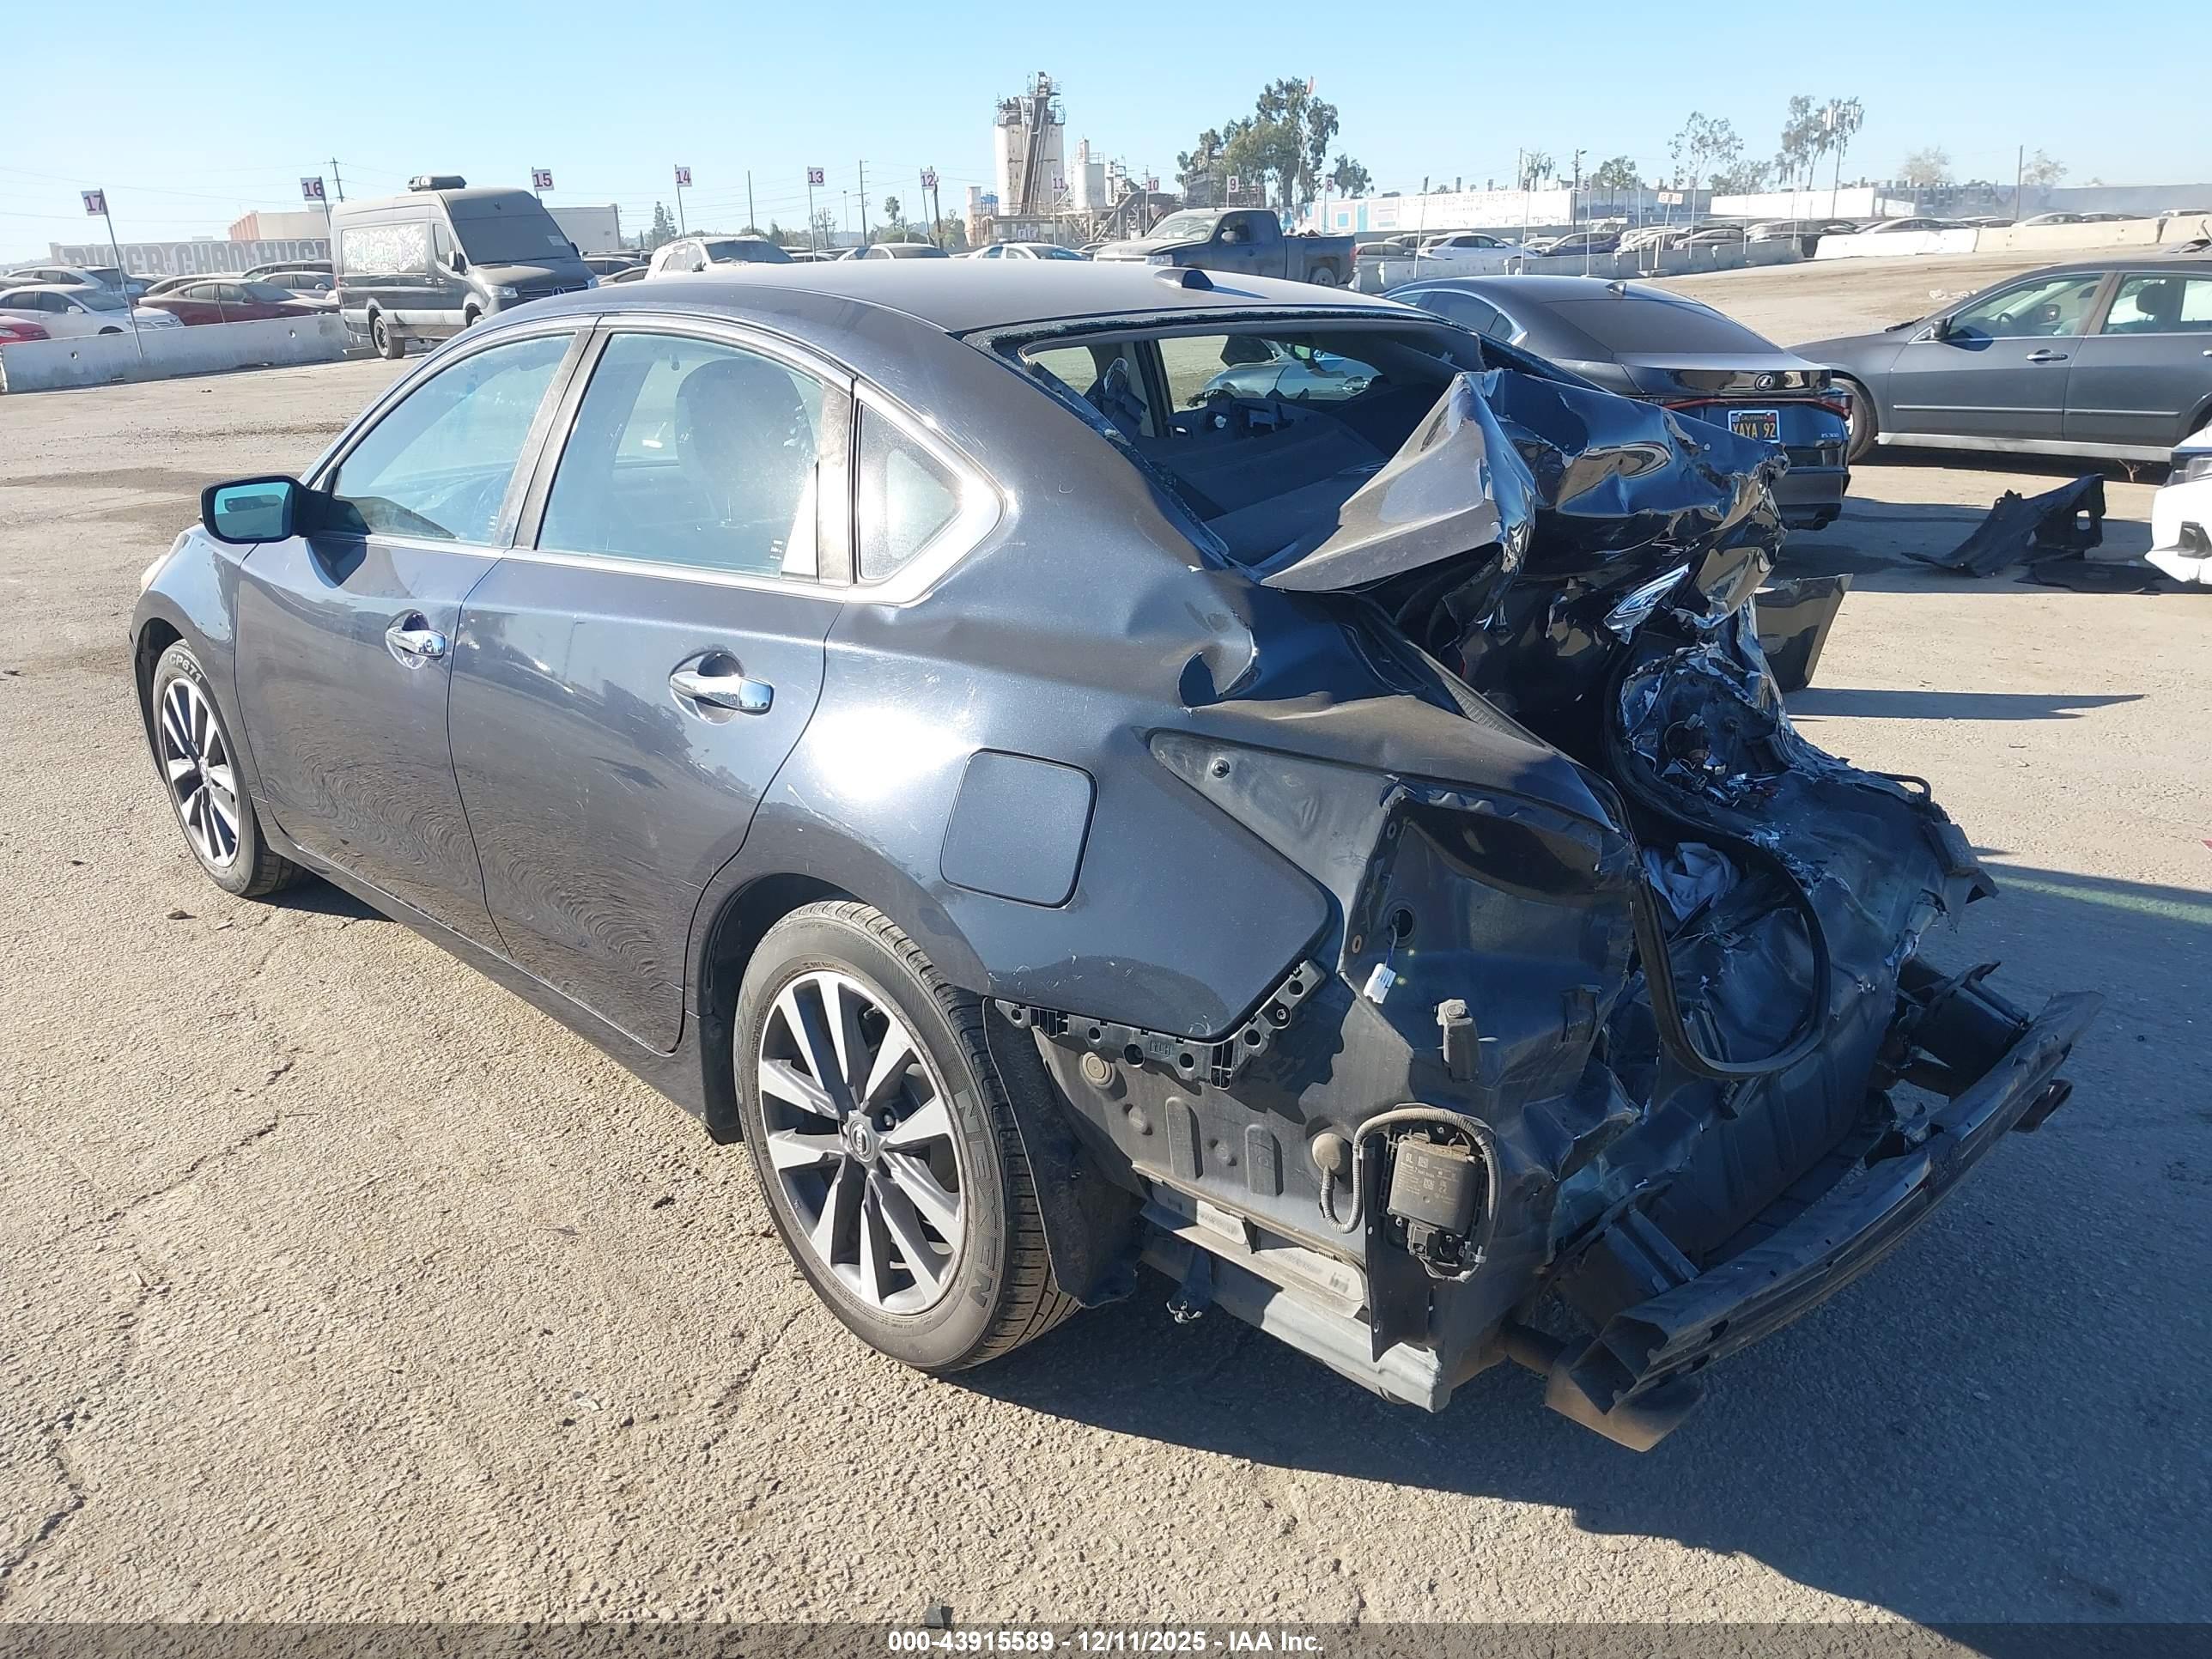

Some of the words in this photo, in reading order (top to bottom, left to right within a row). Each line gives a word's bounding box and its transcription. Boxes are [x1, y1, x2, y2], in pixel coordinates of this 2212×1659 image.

[532, 173, 552, 187] 15
[676, 171, 690, 184] 14
[809, 171, 824, 184] 13
[921, 174, 934, 187] 12
[1053, 178, 1064, 189] 11
[303, 182, 323, 197] 16
[1147, 179, 1159, 191] 10
[1230, 179, 1237, 190] 9
[1327, 179, 1333, 191] 8
[1583, 180, 1589, 191] 5
[83, 195, 103, 212] 17
[1764, 422, 1777, 438] 92
[169, 653, 203, 684] CP671
[954, 1089, 997, 1309] NEXEN
